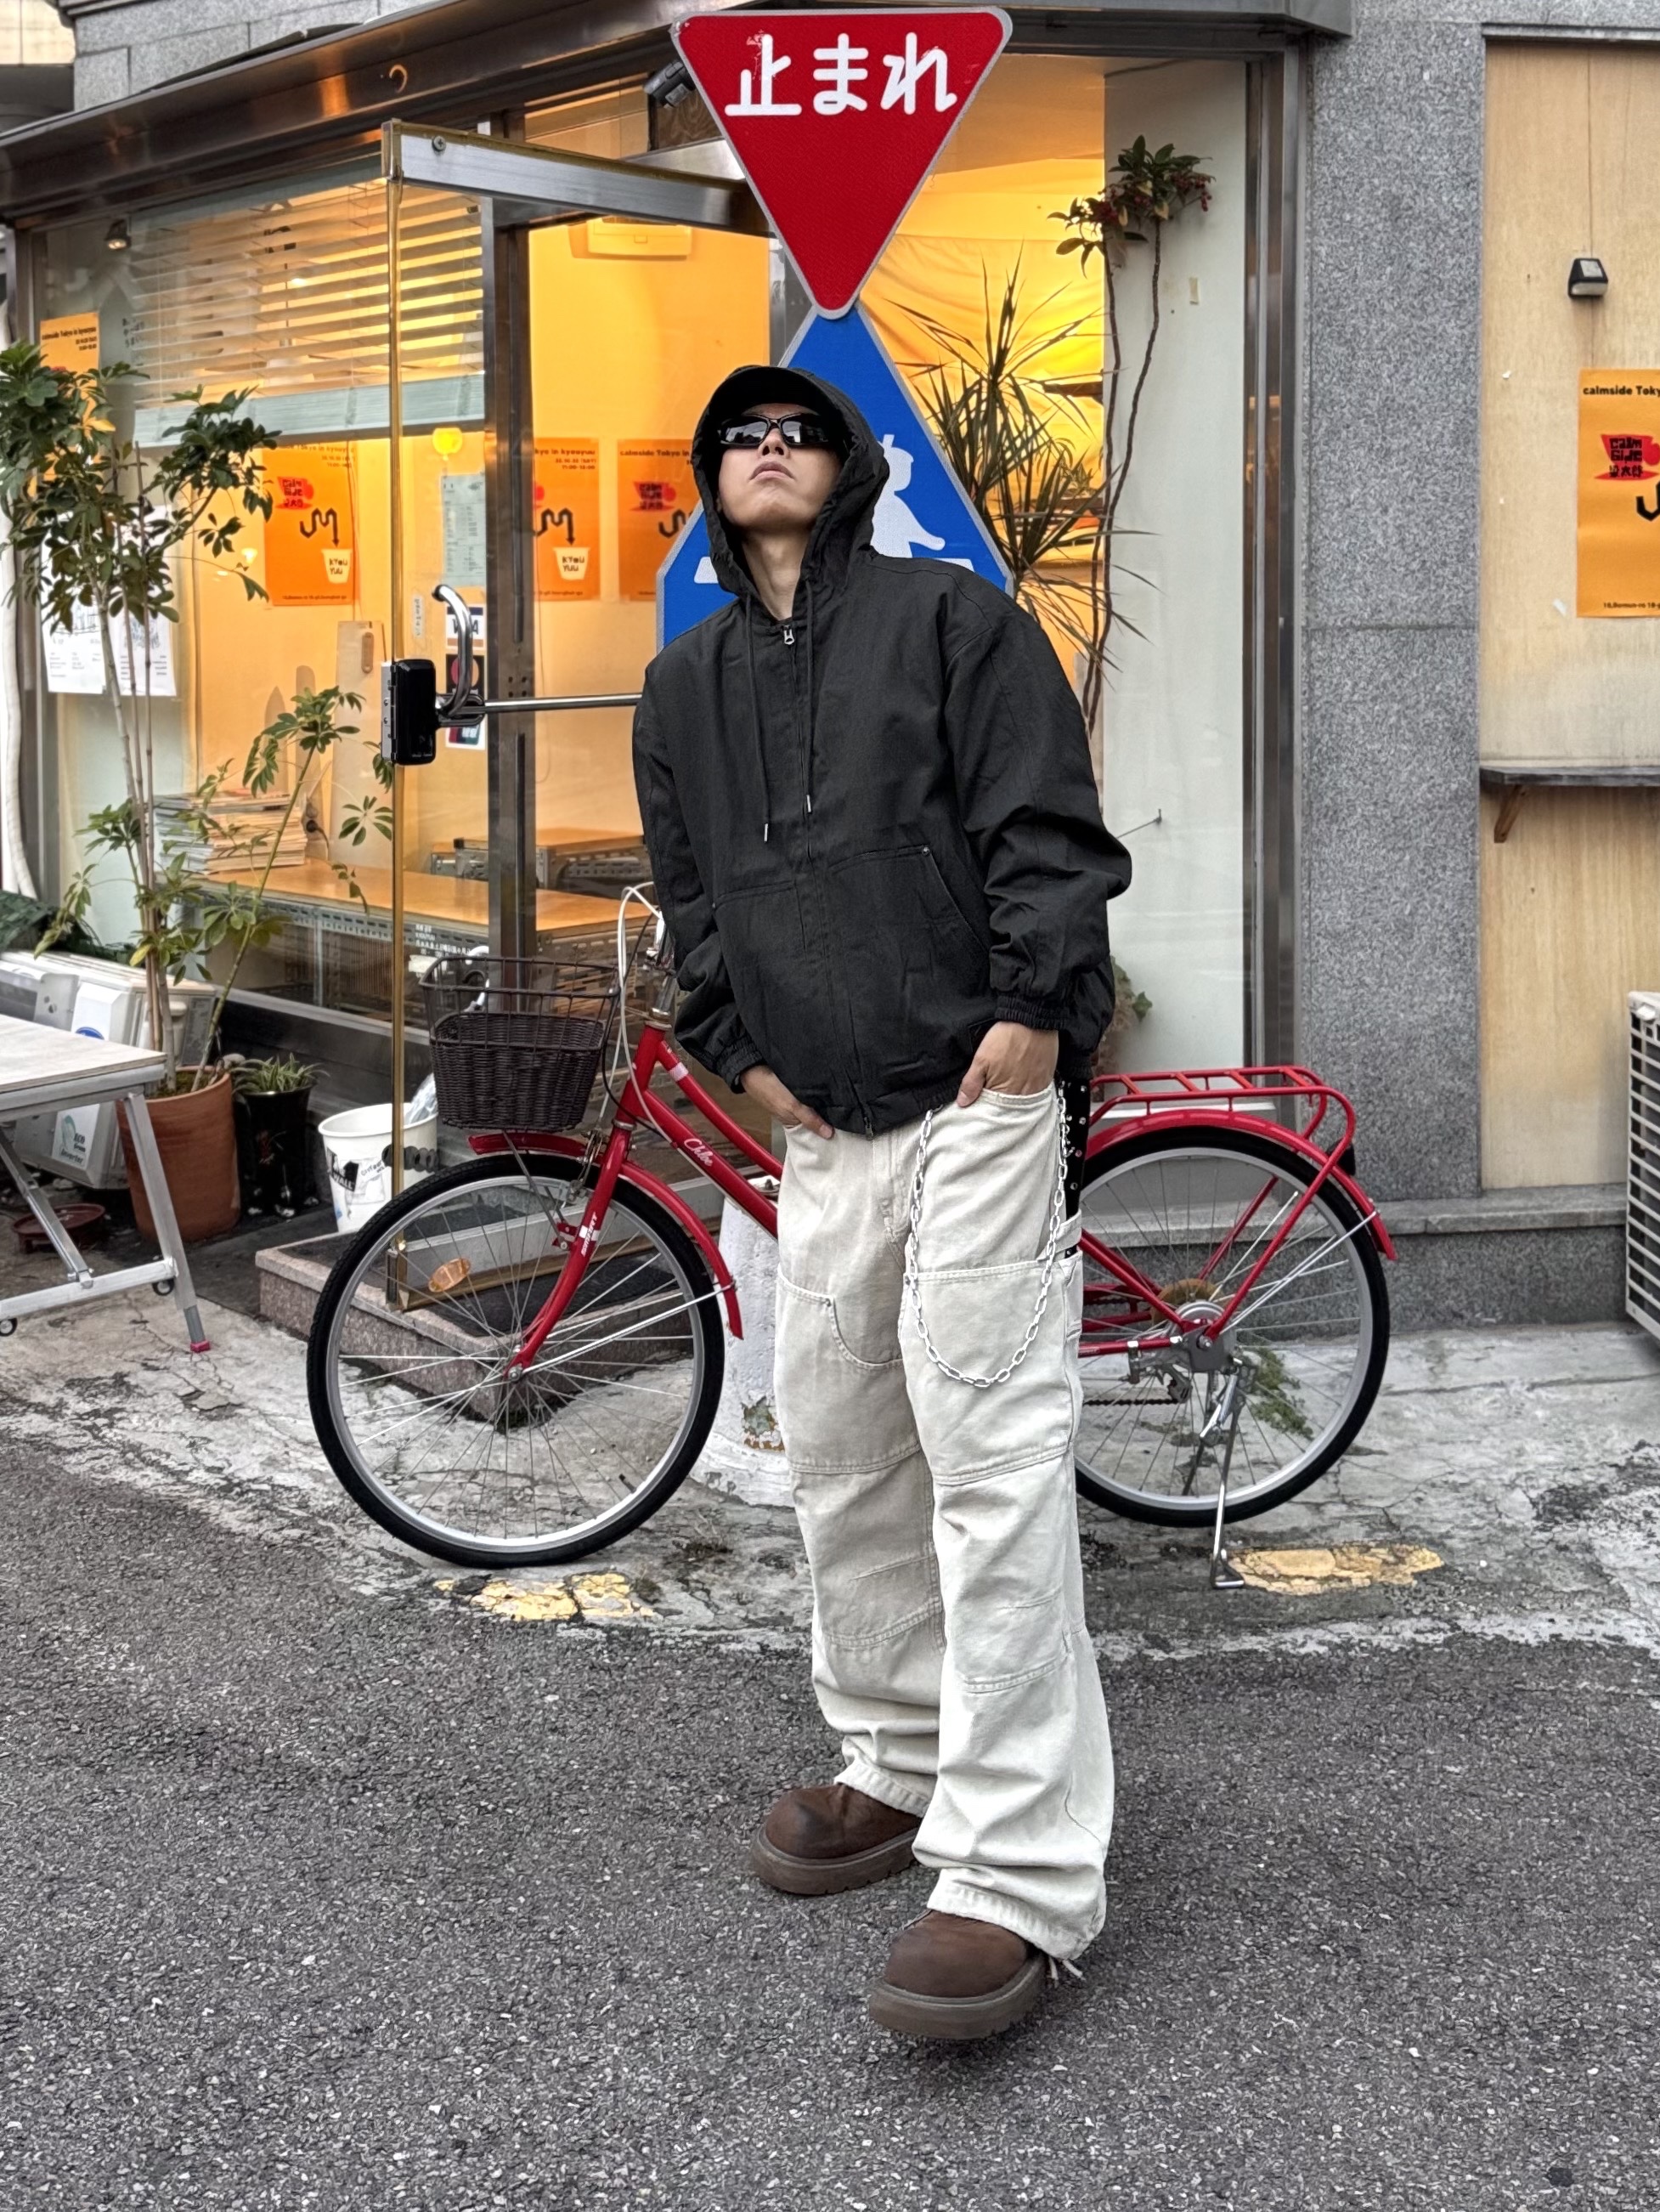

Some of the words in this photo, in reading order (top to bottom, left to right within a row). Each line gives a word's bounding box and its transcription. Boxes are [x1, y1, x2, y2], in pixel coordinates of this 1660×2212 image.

[725, 31, 957, 116] 止まれ
[1583, 385, 1633, 395] calmside
[683, 1138, 714, 1167] Chloe
